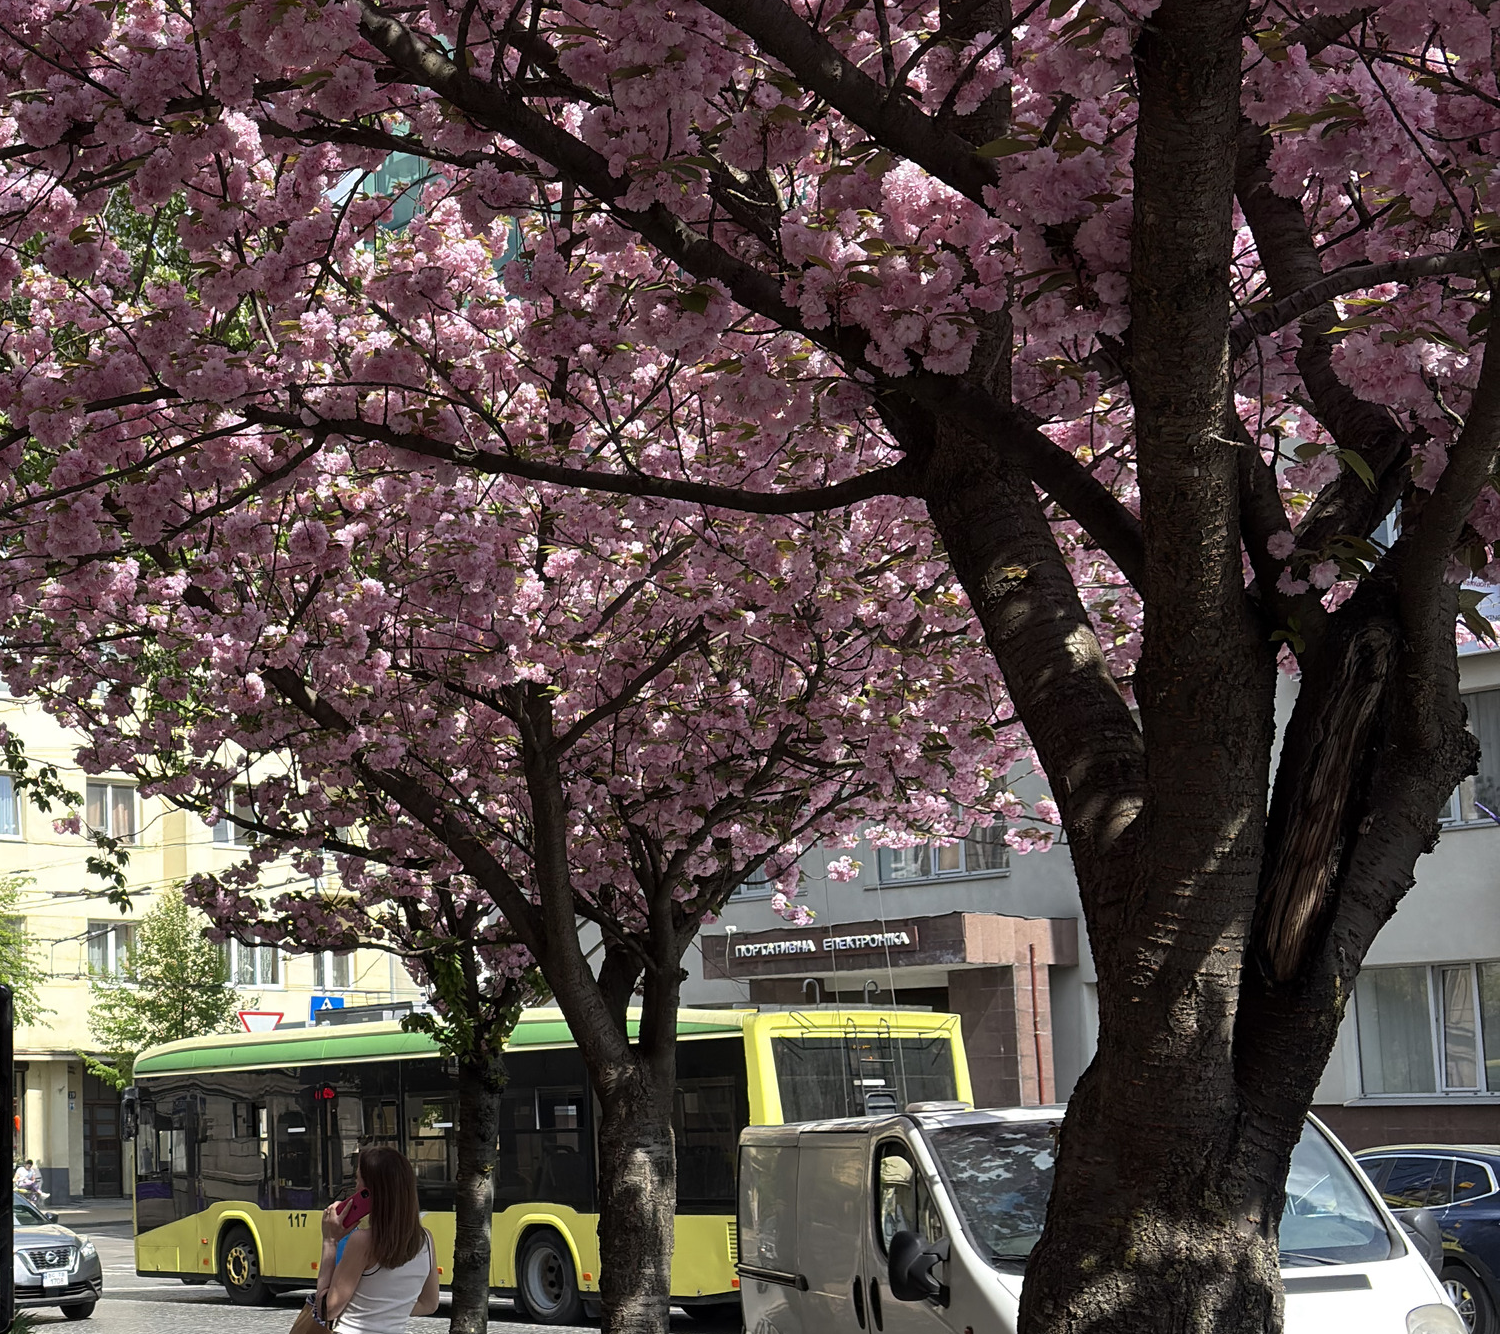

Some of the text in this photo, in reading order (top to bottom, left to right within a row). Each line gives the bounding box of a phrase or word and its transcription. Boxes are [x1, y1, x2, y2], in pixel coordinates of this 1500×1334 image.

[734, 931, 910, 958] ПОРТАТИВНА ЕЛЕКТРОНІКА
[288, 1213, 307, 1228] 117
